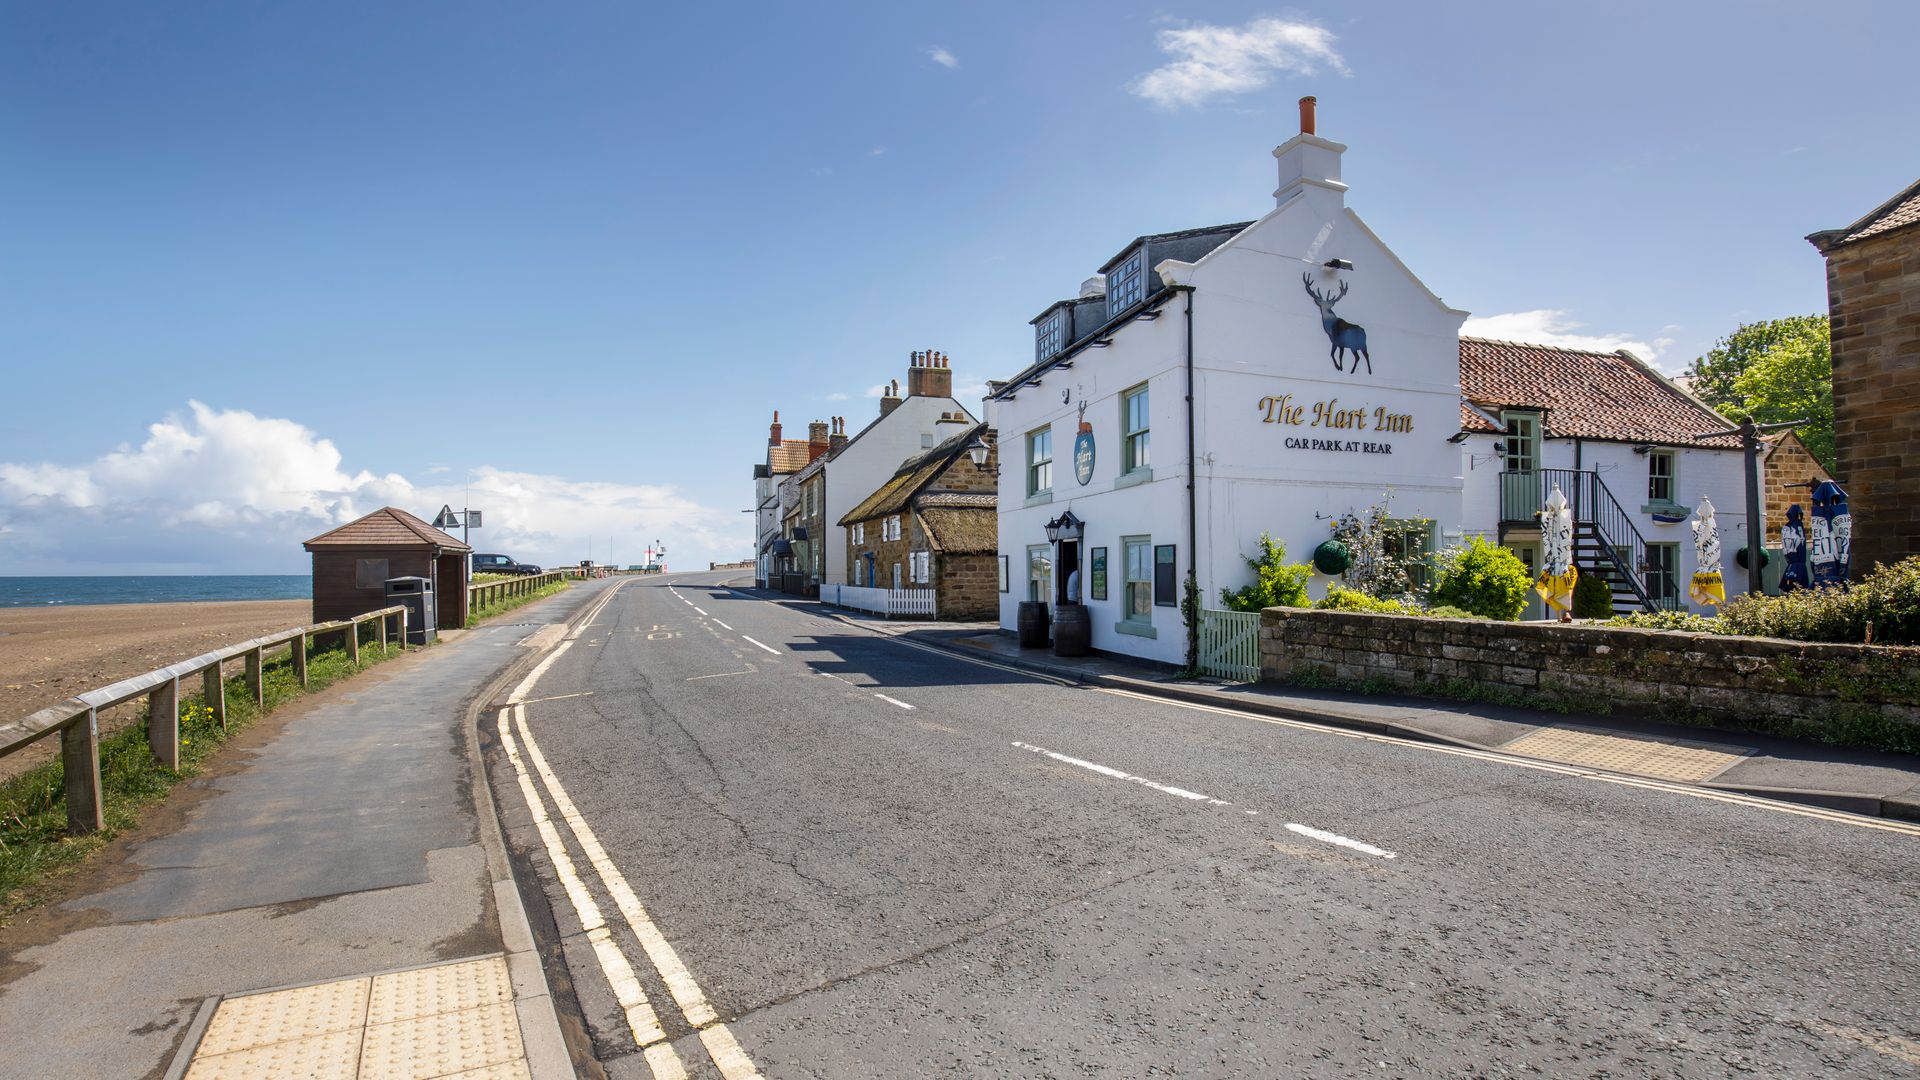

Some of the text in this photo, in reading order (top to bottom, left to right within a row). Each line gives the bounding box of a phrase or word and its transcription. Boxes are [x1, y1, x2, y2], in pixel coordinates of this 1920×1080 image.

[1258, 393, 1414, 433] The Hart Inn
[1285, 437, 1392, 455] CAR PARK AT REAR
